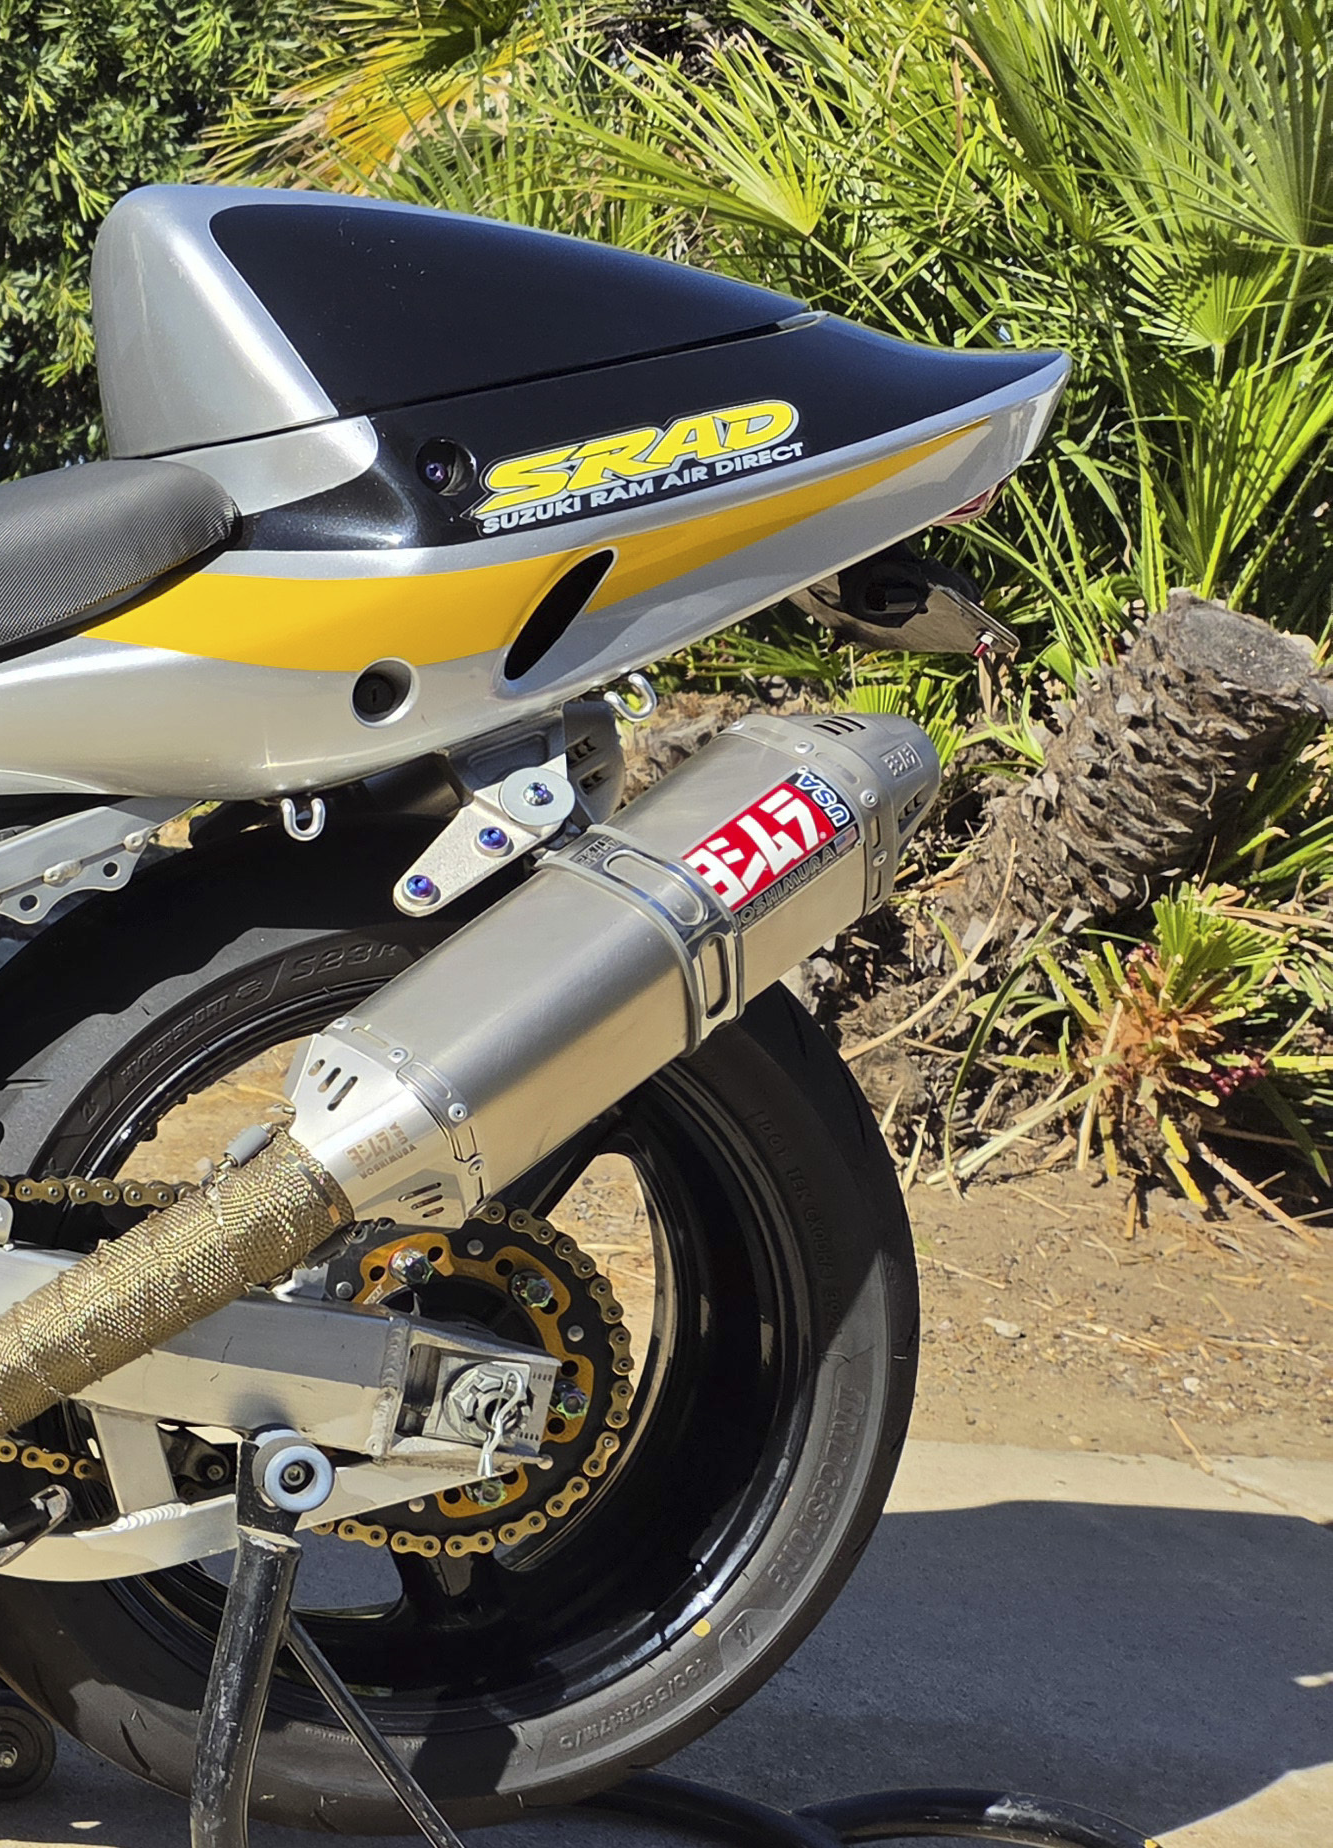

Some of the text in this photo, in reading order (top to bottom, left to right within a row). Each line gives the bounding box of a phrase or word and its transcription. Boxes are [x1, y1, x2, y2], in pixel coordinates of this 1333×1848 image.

[474, 400, 797, 515] SRAD
[482, 441, 805, 535] SUZUKI RAM AIR DIRECT
[794, 772, 851, 828] USA
[684, 789, 820, 909] ヨシムラ
[119, 994, 231, 1087] HYPERSPORT
[359, 1143, 418, 1180] YOSHIMURA
[767, 1382, 868, 1590] BRIDGESTONE
